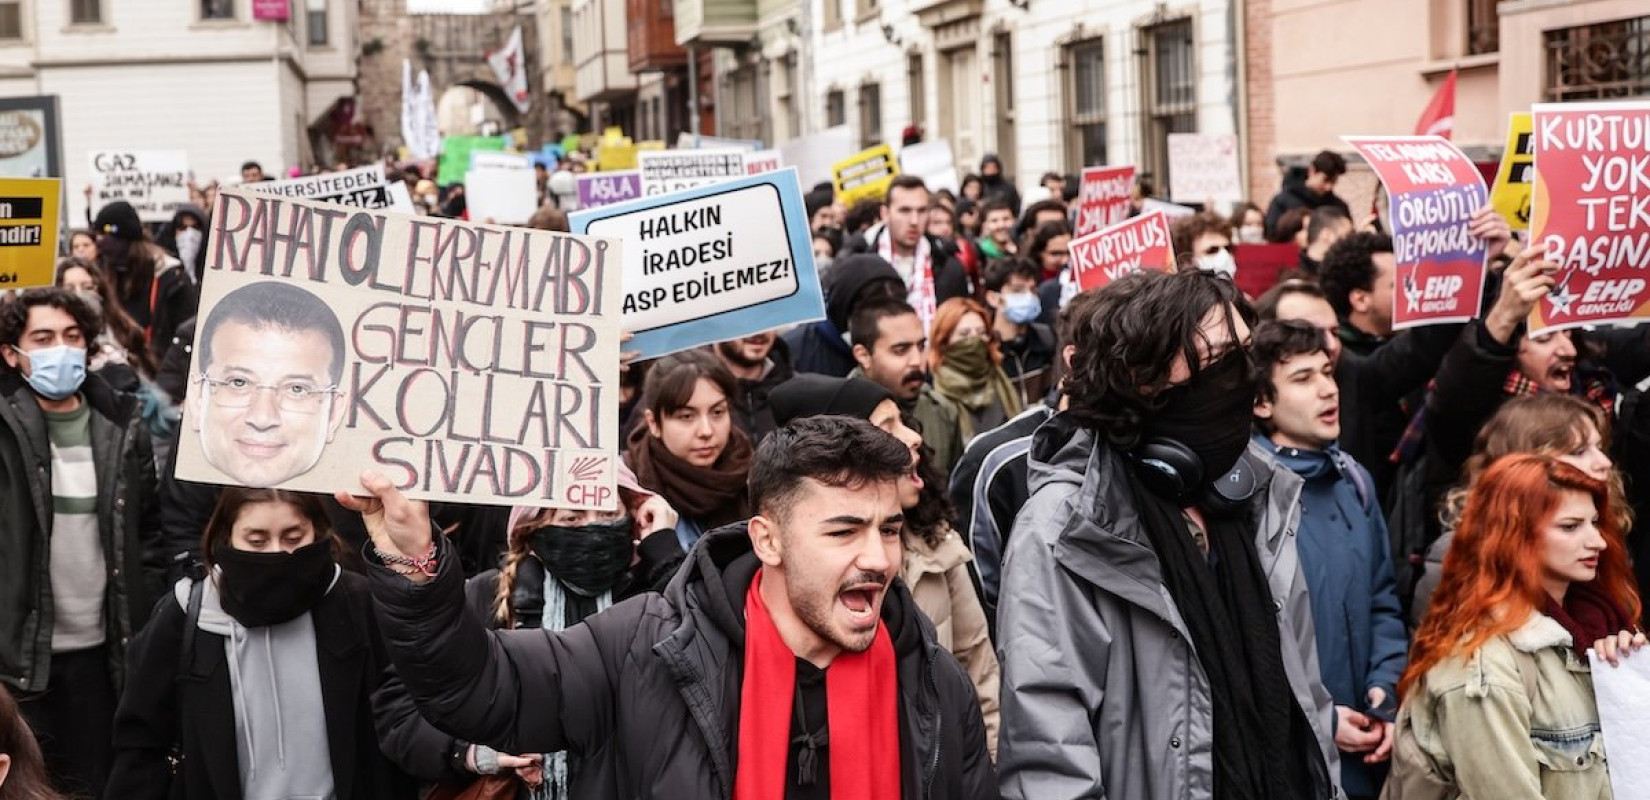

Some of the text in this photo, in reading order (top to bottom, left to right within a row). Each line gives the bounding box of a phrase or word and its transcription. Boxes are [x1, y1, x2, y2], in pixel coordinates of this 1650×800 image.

[95, 153, 138, 172] GAZ
[1401, 161, 1457, 187] KARŞI
[1581, 154, 1650, 194] YOK
[589, 177, 635, 200] ASLA
[1398, 183, 1480, 228] ÖRGÜTLÜ
[640, 204, 721, 241] HALKIN
[1576, 194, 1650, 232] TEK
[210, 193, 608, 316] RAHAT OL EKREM ABİ
[643, 231, 734, 276] İRADESİ
[1076, 216, 1167, 272] KURTULUŞ
[672, 258, 790, 304] EDİLEMEZ!
[1423, 274, 1463, 299] EHP
[1581, 278, 1646, 302] EHP
[351, 301, 601, 383] GENÇLER
[345, 361, 603, 450] KOLLARI
[372, 436, 560, 500] SIVADI
[566, 484, 612, 506] CHP
